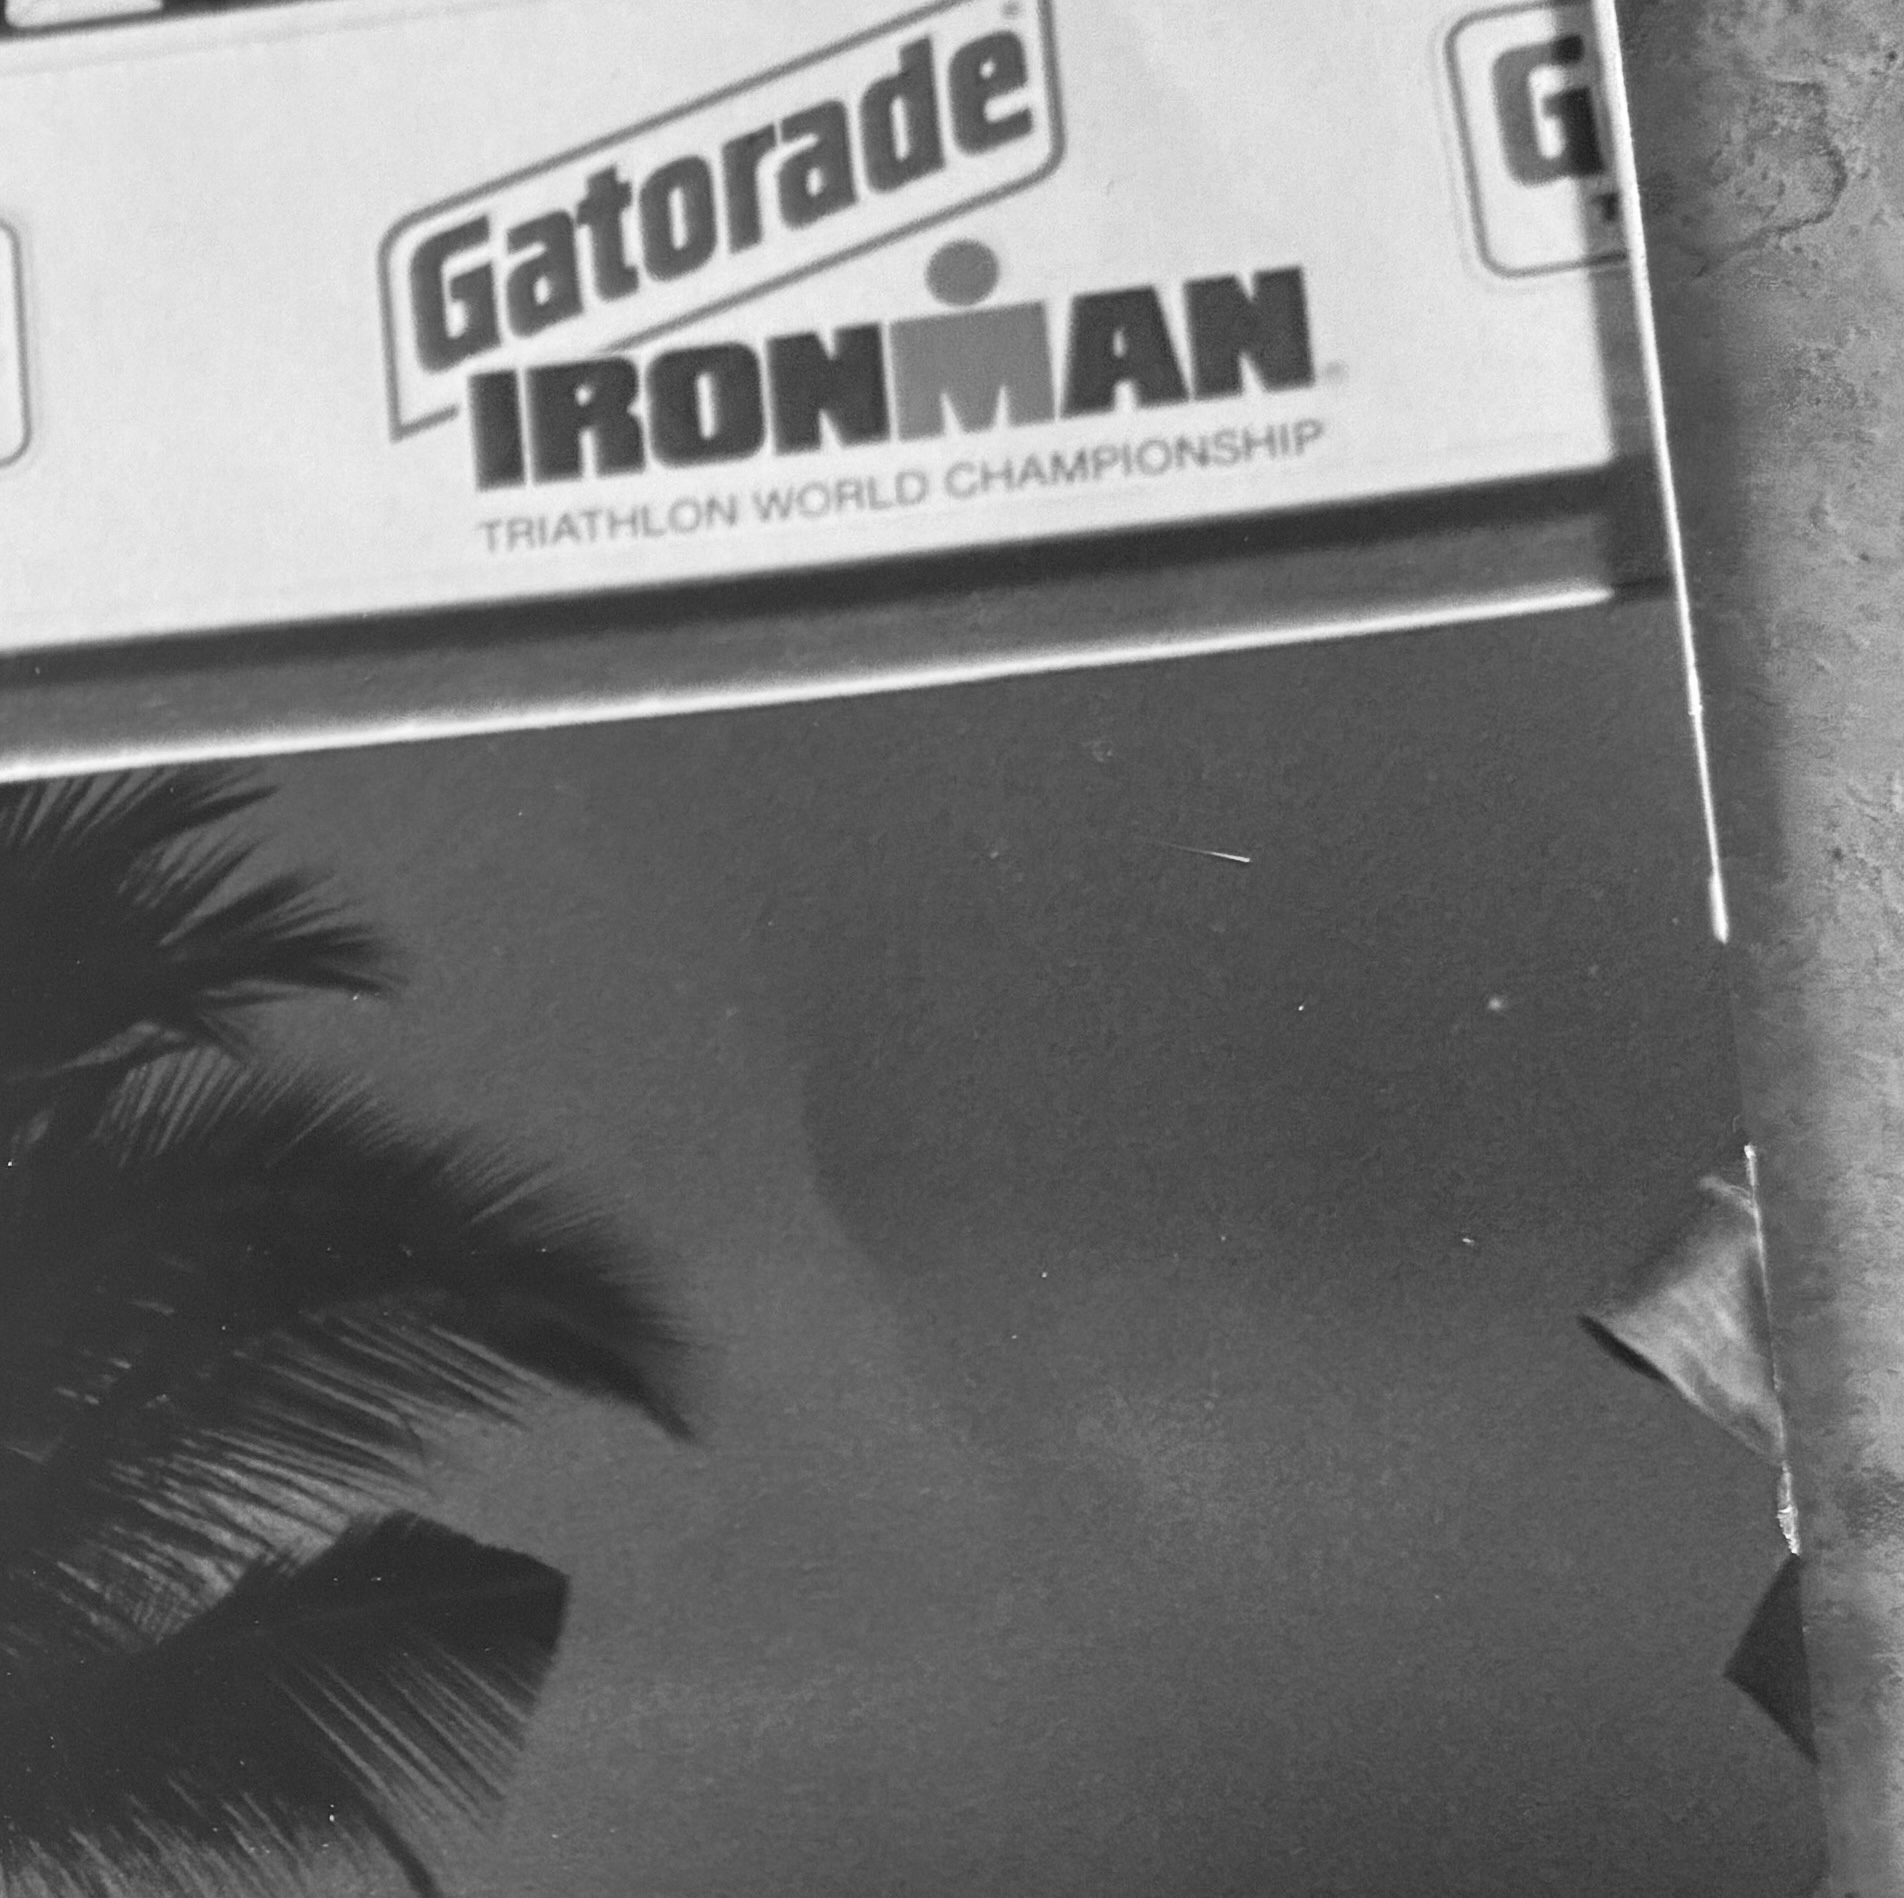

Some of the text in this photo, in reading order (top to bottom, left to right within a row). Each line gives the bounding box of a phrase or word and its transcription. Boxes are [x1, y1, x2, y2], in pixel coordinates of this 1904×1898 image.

[409, 27, 1036, 374] Gatorade
[466, 238, 1318, 492] IRONMAN
[476, 418, 1326, 556] TRIATHLON WORLD CHAMPIONSHIP
